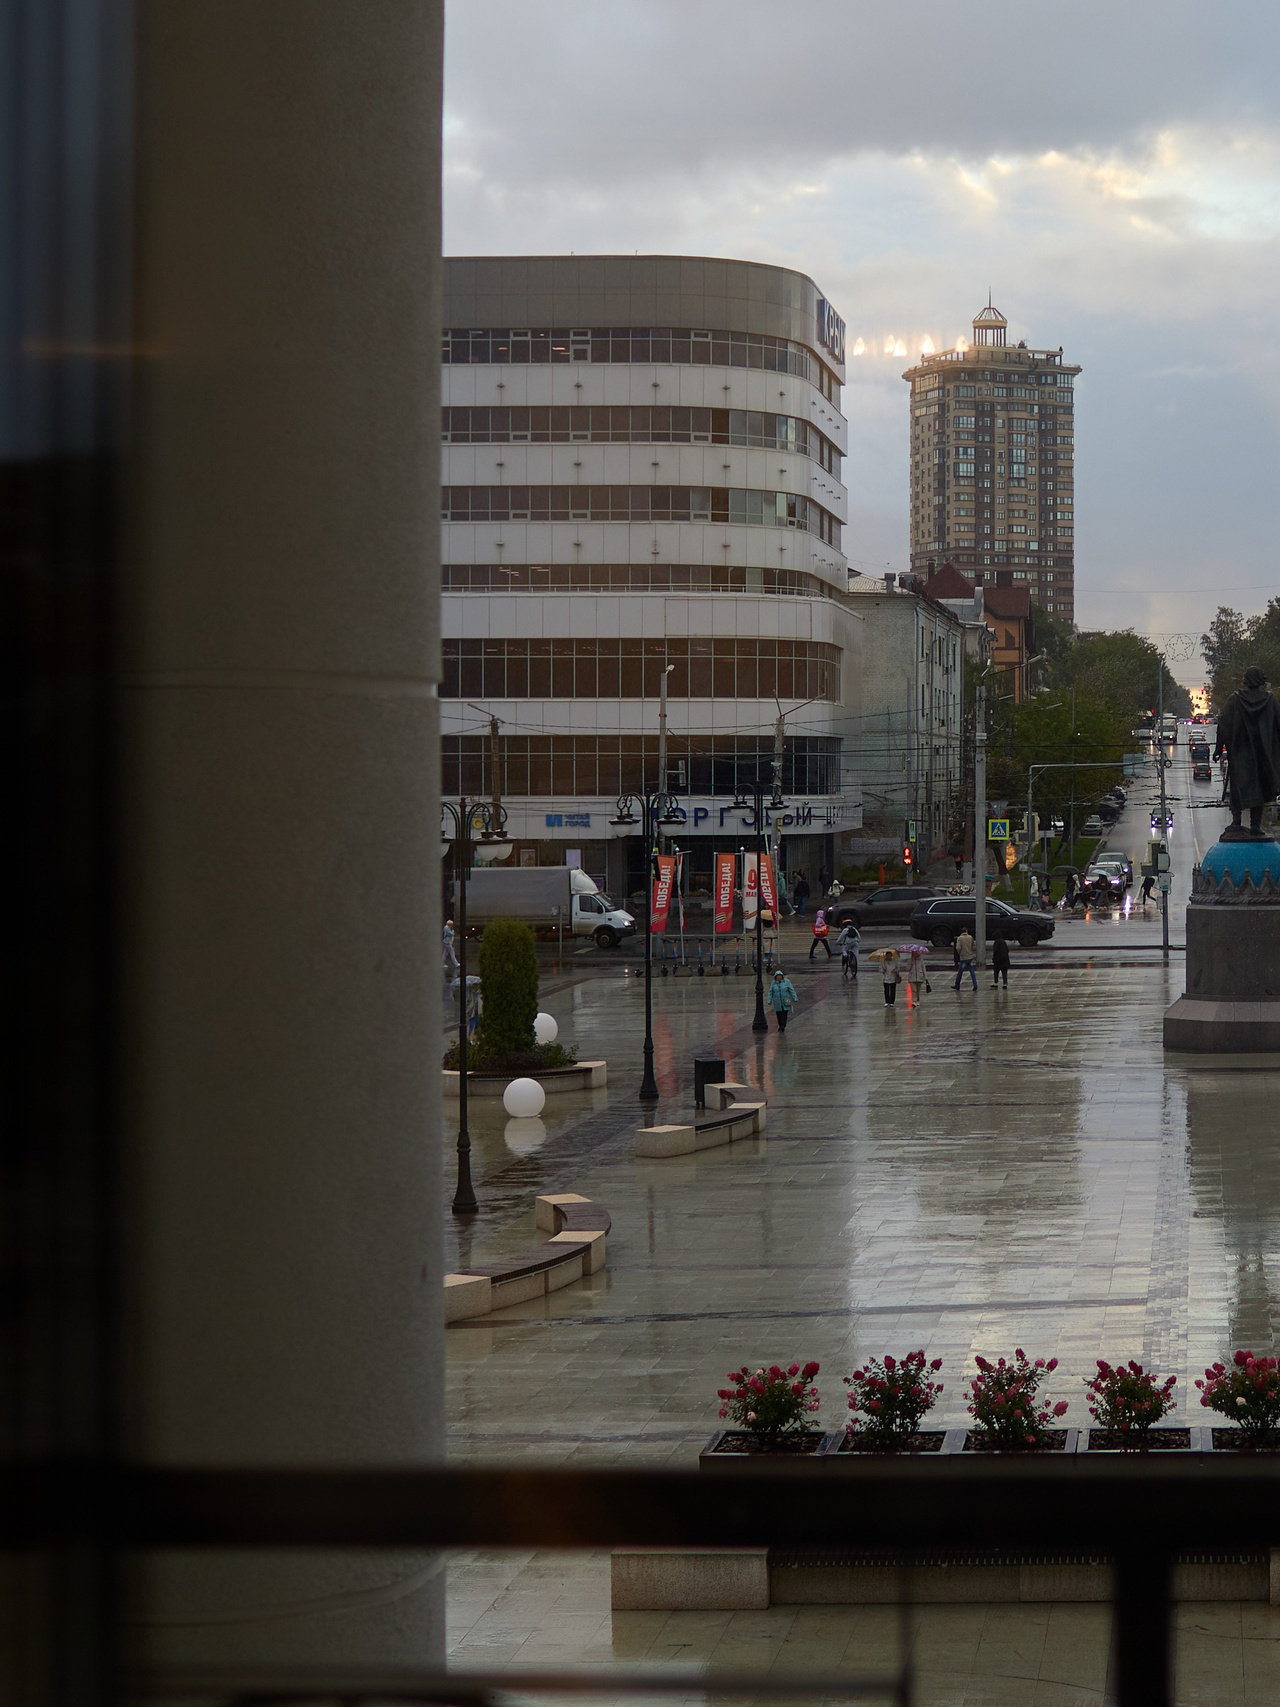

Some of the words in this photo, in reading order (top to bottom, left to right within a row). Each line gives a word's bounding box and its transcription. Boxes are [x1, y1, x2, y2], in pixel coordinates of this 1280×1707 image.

[824, 300, 845, 362] КРЫМ
[564, 820, 591, 828] ГОРОД
[656, 865, 672, 909] ПОБЕДА!
[720, 862, 733, 908] ПОБЕДА!
[747, 868, 758, 890] 9
